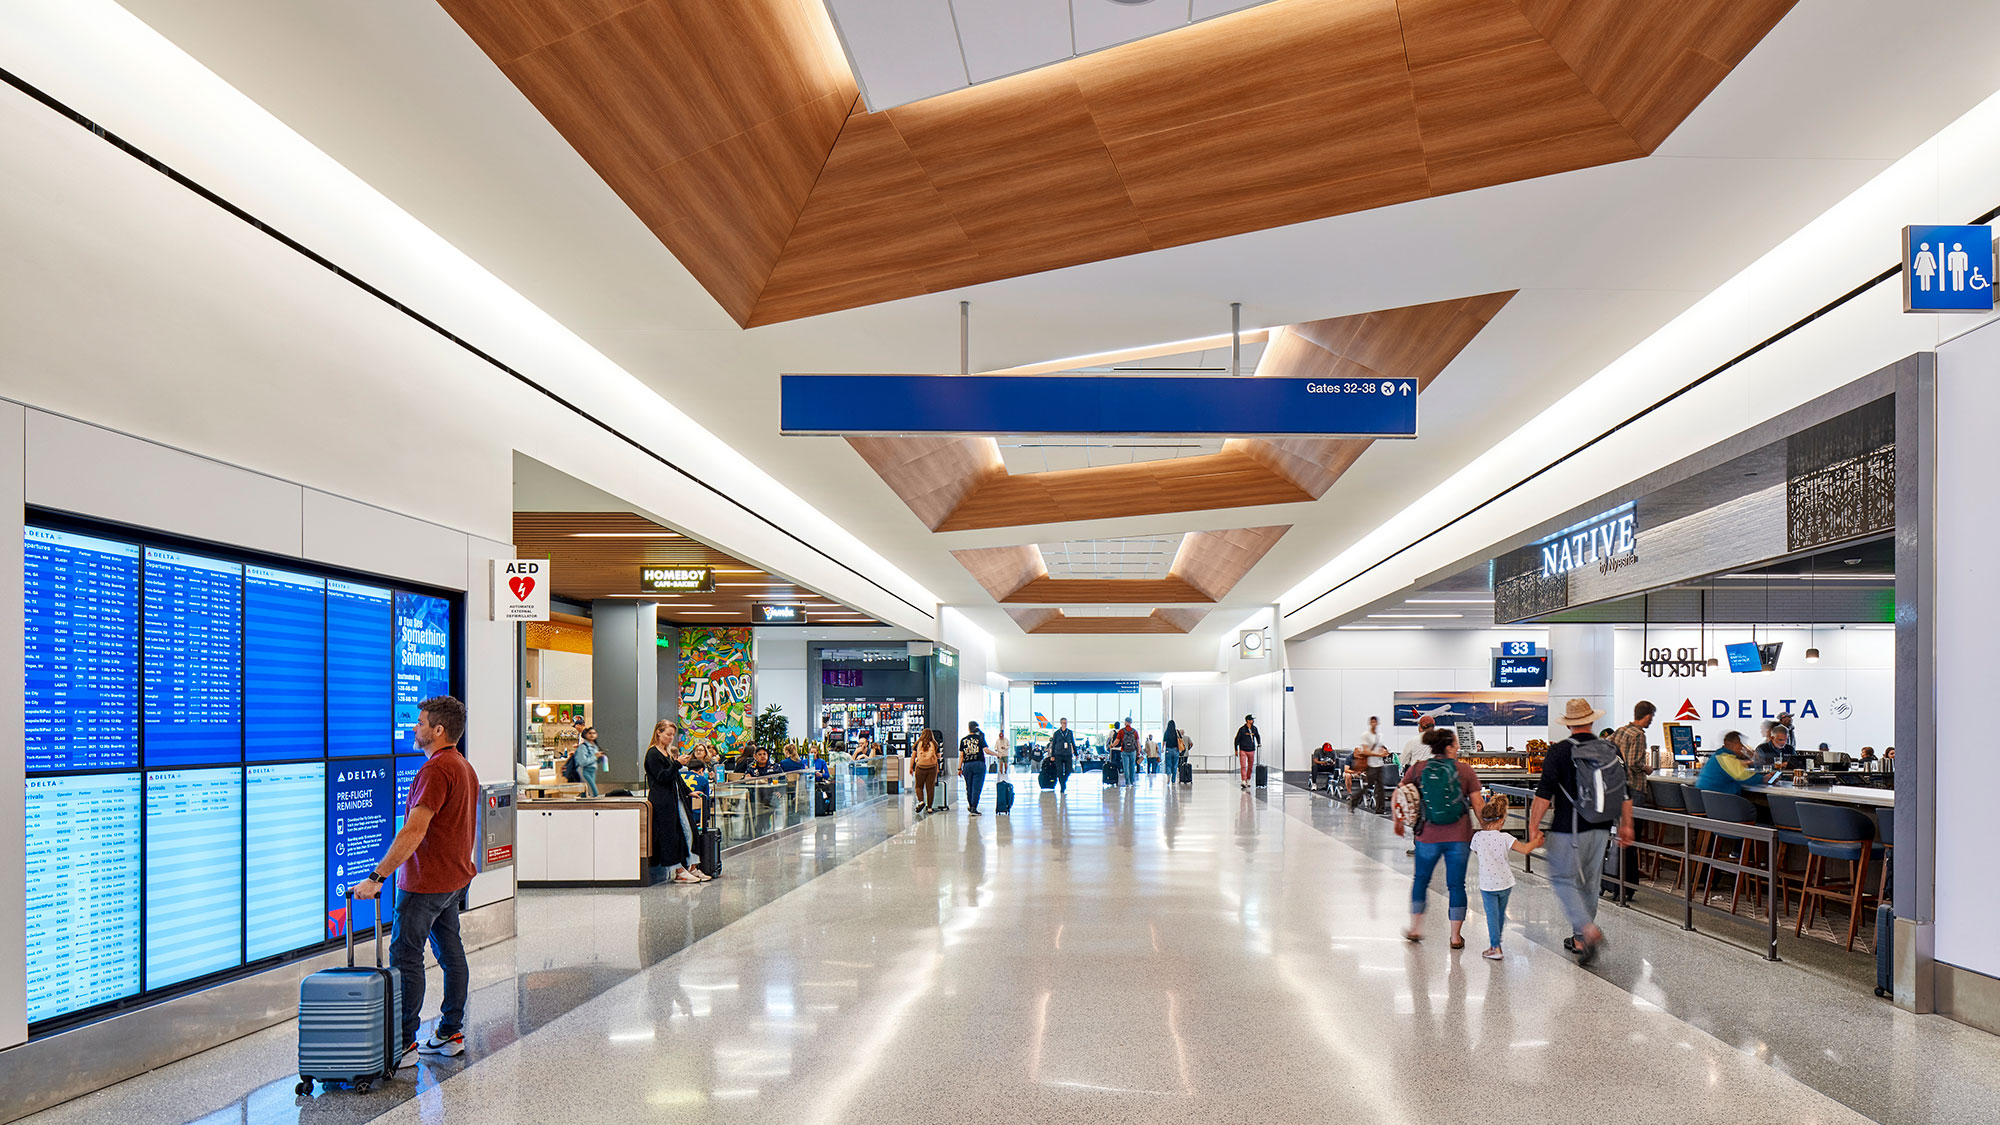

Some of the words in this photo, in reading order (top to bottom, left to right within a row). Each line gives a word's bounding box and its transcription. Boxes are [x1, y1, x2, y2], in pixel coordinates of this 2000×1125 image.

[1306, 382, 1341, 394] Gates
[1343, 382, 1377, 394] 32-38
[29, 530, 55, 540] DELTA
[1542, 513, 1634, 578] NATIVE
[153, 551, 175, 560] DELTA
[145, 561, 171, 571] Departures
[505, 562, 539, 574] AED
[1600, 562, 1607, 576] by
[251, 568, 270, 577] DELTA
[644, 569, 706, 581] HOMEBOY
[245, 577, 267, 586] Departures
[403, 616, 413, 627] You
[413, 617, 423, 629] See
[401, 626, 446, 648] Something
[407, 641, 417, 653] Say
[1510, 642, 1529, 655] 33
[401, 649, 446, 670] Something
[1527, 666, 1540, 675] City
[682, 673, 752, 711] JAMBA
[1712, 699, 1819, 719] DELTA
[347, 769, 378, 781] DELTA
[336, 789, 373, 801] PRE-FLIGHT
[336, 799, 373, 811] REMINDERS
